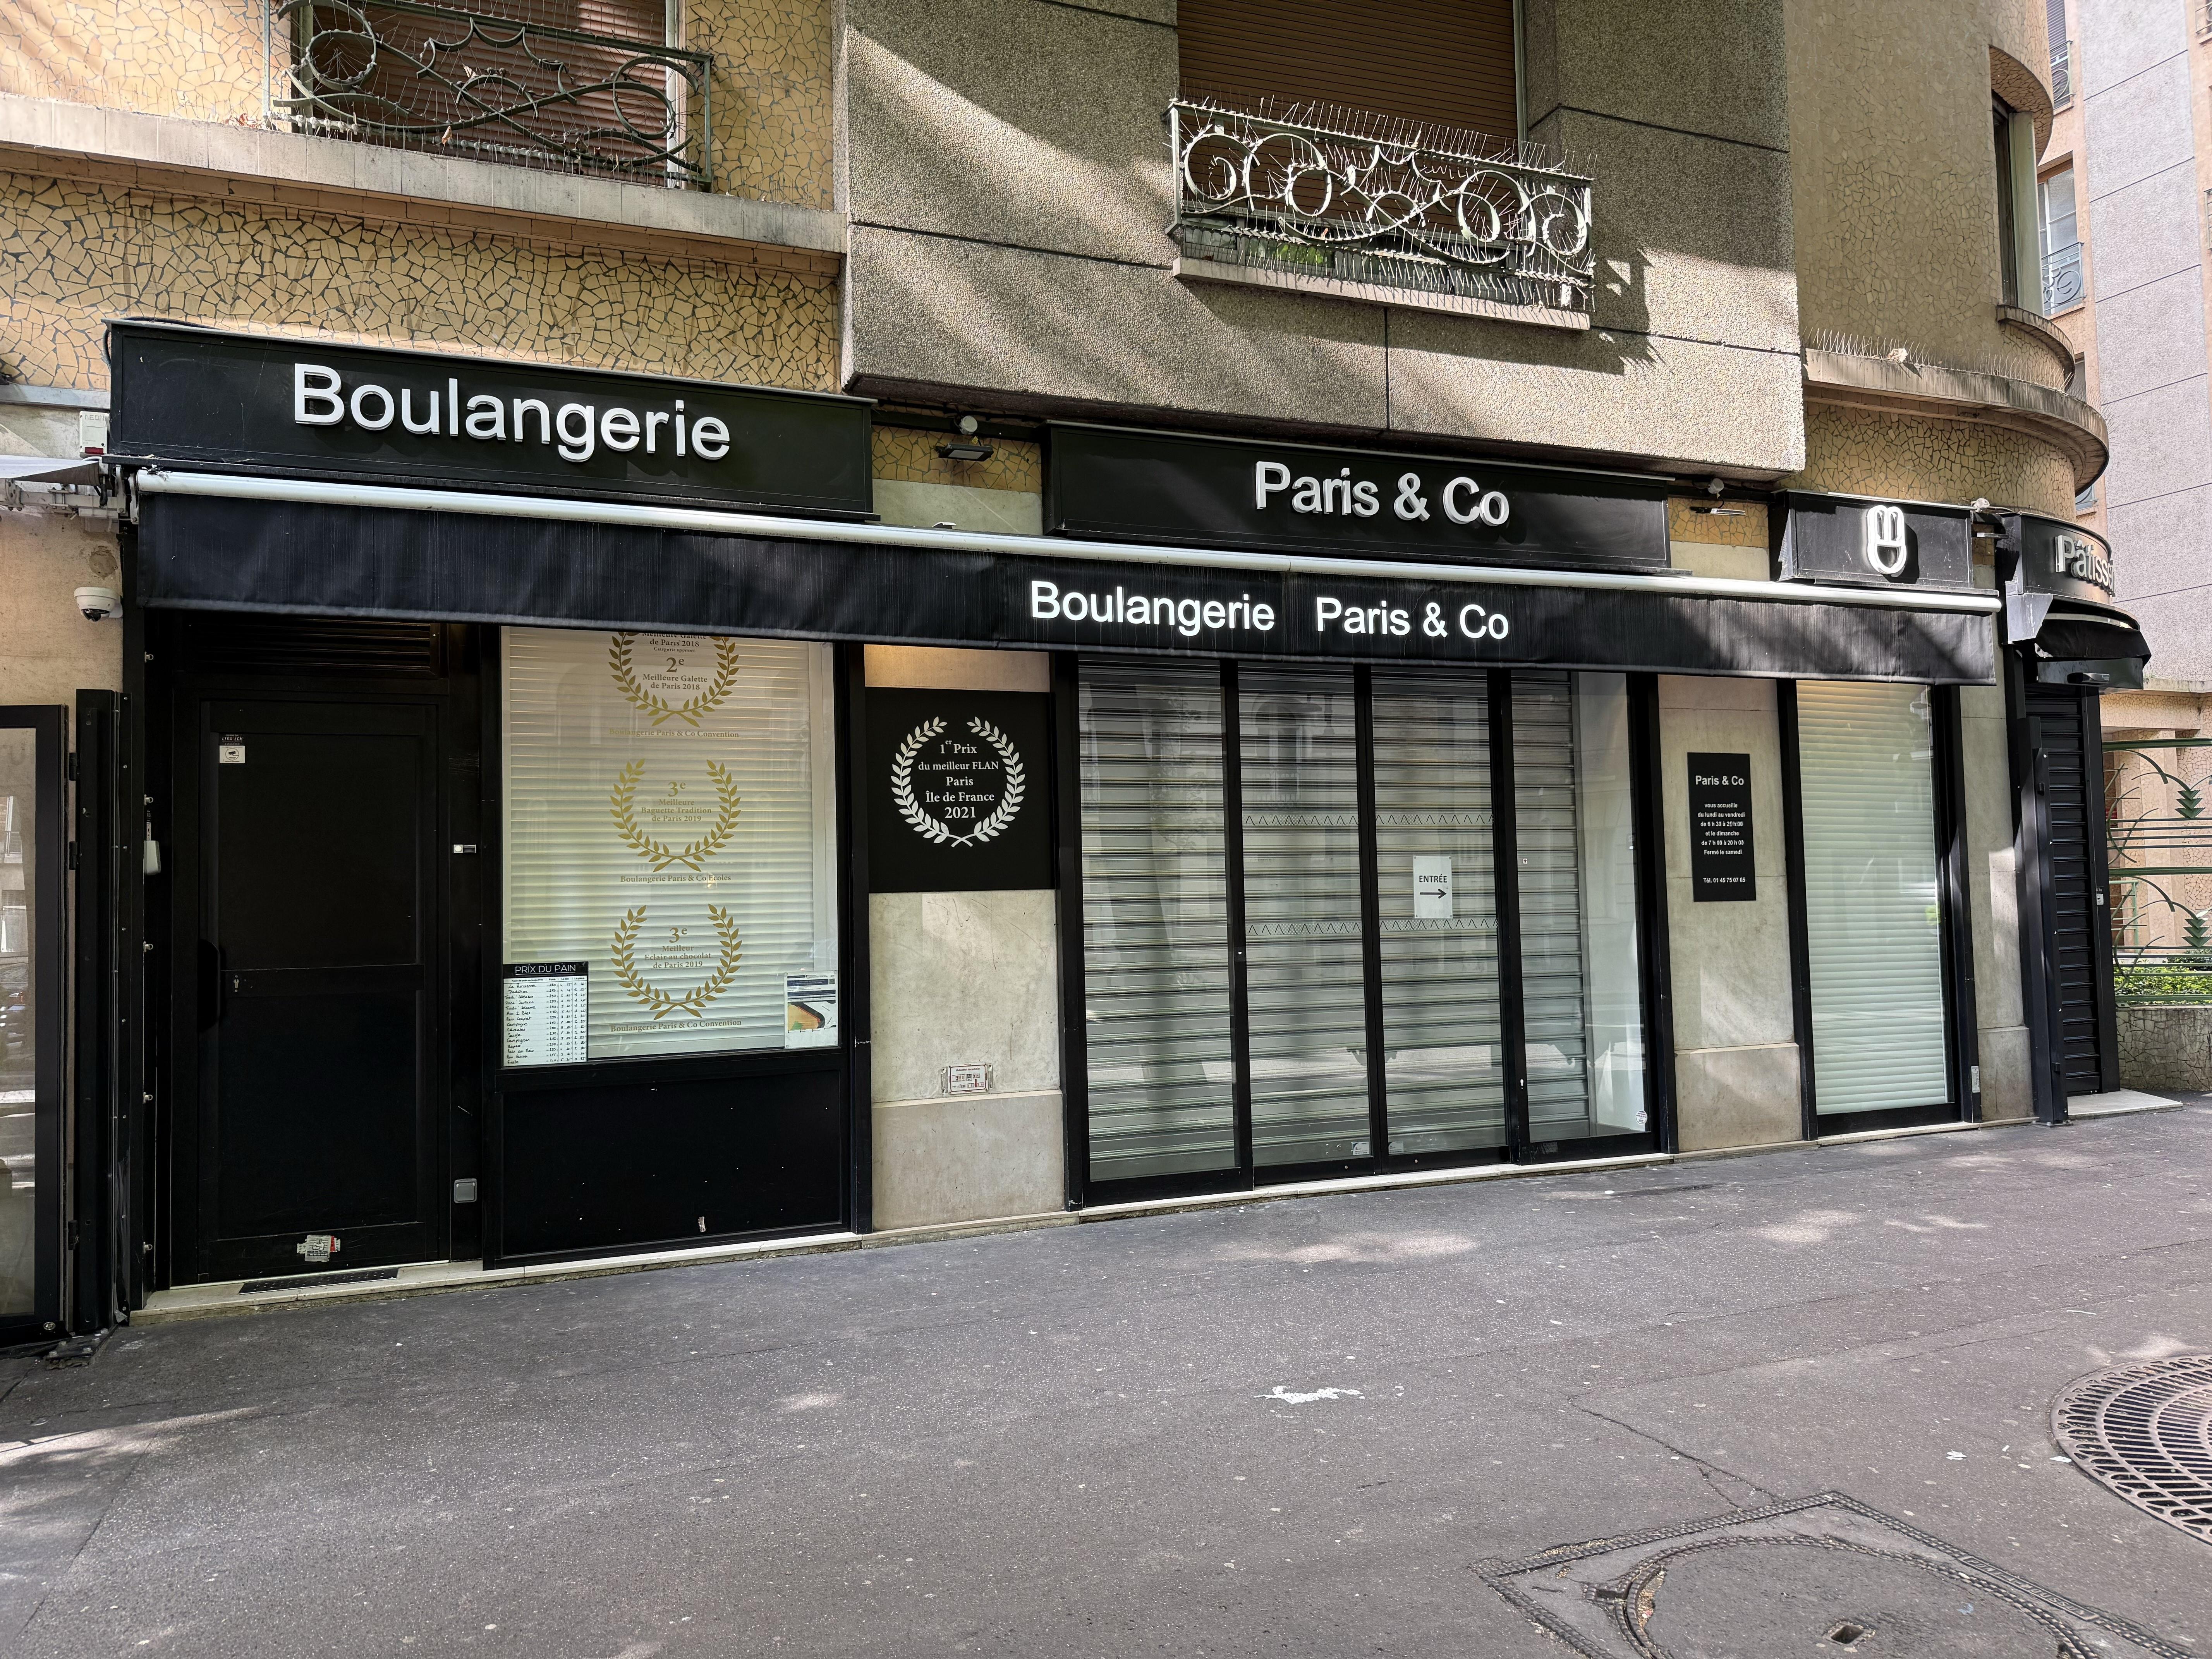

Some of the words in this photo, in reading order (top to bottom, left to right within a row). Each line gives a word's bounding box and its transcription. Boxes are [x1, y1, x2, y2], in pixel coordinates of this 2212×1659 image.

[294, 362, 730, 463] Boulangerie
[1255, 460, 1380, 517] Paris
[1393, 472, 1431, 522] &
[1443, 476, 1510, 527] Co
[1031, 580, 1275, 637] Boulangerie
[1316, 596, 1411, 636] Paris
[1423, 602, 1448, 638] &
[1460, 604, 1510, 640] Co
[666, 657, 684, 673] 2e
[643, 673, 679, 682] Meilleure
[609, 728, 654, 737] Boulangerie
[940, 740, 952, 754] 1er
[954, 744, 977, 754] Prix
[918, 762, 930, 770] du
[933, 761, 970, 770] meilleur
[972, 761, 999, 770] FLAN
[946, 776, 974, 786] Paris
[1695, 775, 1719, 785] Paris
[1722, 776, 1729, 785] &
[1731, 776, 1744, 785] Co
[668, 781, 686, 797] 3e
[926, 790, 940, 802] Île
[943, 792, 955, 802] de
[958, 792, 995, 802] France
[641, 807, 674, 815] Baguette
[945, 807, 976, 819] 2021
[620, 875, 666, 883] Boulangerie
[1419, 874, 1447, 883] ENTRÉE
[669, 927, 687, 943] 3e
[611, 1025, 656, 1033] Boulangerie
[699, 1020, 742, 1028] Convention
